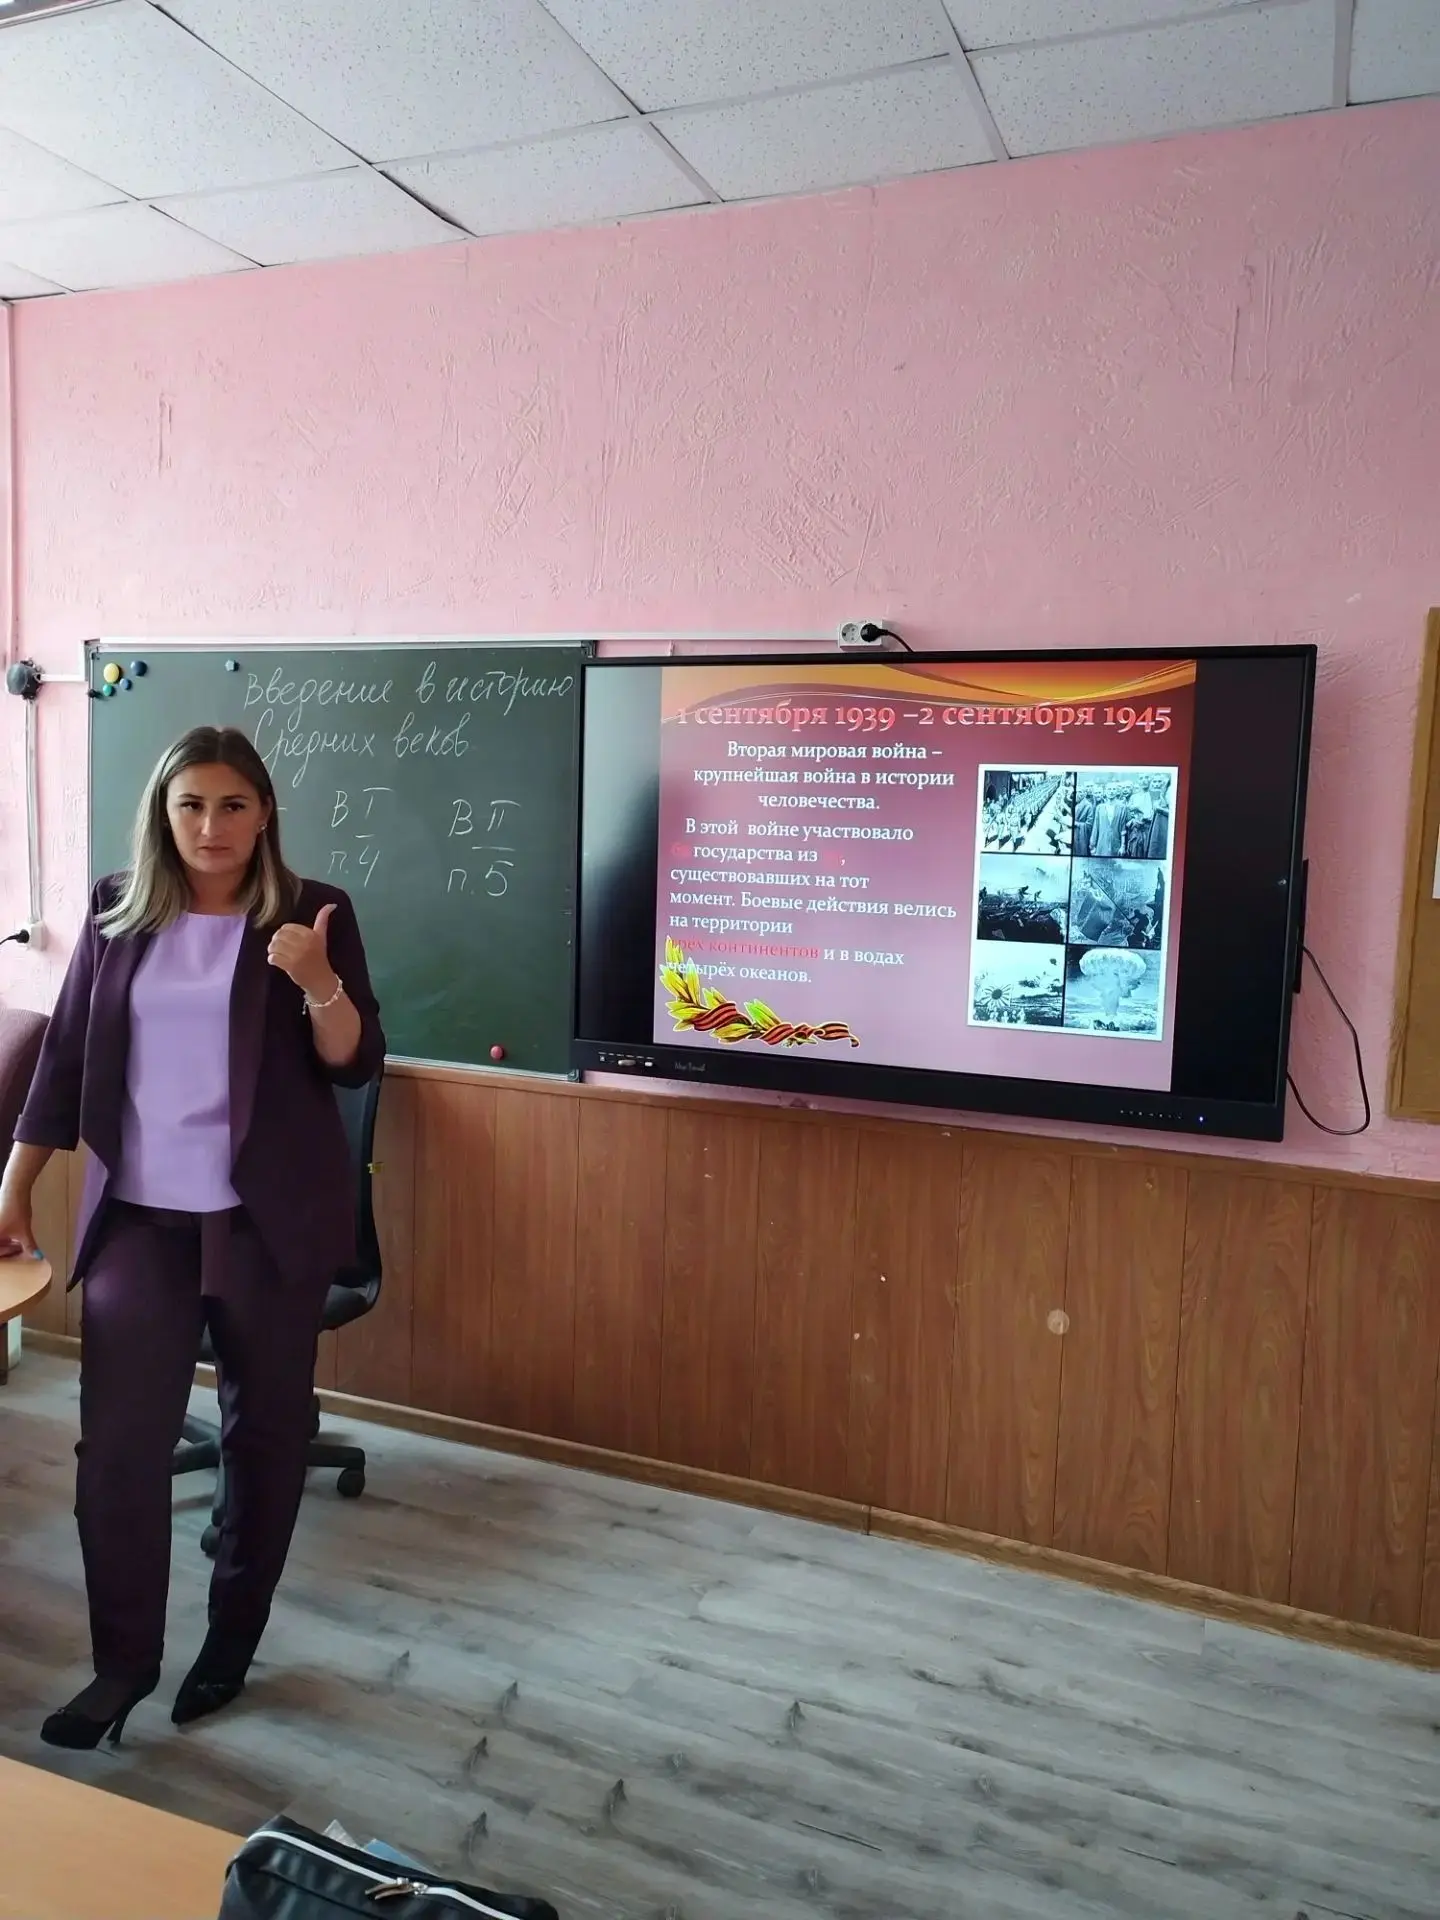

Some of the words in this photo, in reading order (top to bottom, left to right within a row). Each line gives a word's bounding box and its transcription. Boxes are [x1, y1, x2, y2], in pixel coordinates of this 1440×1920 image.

[244, 667, 394, 732] Введение
[416, 661, 437, 704] в
[447, 667, 575, 716] историю
[677, 708, 688, 724] 1
[694, 698, 828, 732] сентября
[834, 707, 896, 732] 1939
[942, 702, 1095, 733] сентября
[1103, 706, 1172, 734] 1945
[253, 708, 376, 787] Средних
[393, 711, 472, 758] веков
[727, 740, 786, 762] Вторая
[791, 747, 868, 763] мировая
[872, 742, 927, 759] война
[693, 767, 798, 786] крупнейшая
[803, 767, 856, 784] война
[861, 773, 871, 784] в
[876, 773, 955, 790] истории
[758, 794, 880, 810] человечества.
[685, 818, 696, 833] В
[700, 818, 739, 835] этой
[747, 818, 799, 837] войне
[803, 825, 914, 842] участвовало
[693, 844, 793, 865] государства
[798, 849, 818, 863] из
[670, 867, 811, 888] существовавших
[814, 873, 836, 888] на
[839, 875, 869, 889] тот
[670, 890, 735, 908] момент.
[740, 891, 803, 910] Боевые
[806, 897, 889, 916] действия
[893, 901, 957, 919] велись
[669, 914, 688, 927] на
[692, 914, 794, 937] территории
[708, 940, 820, 960] континентов
[823, 948, 835, 961] и
[839, 949, 850, 962] в
[853, 948, 905, 965] водах
[666, 959, 736, 981] чеырёх
[738, 967, 812, 984] океанов.
